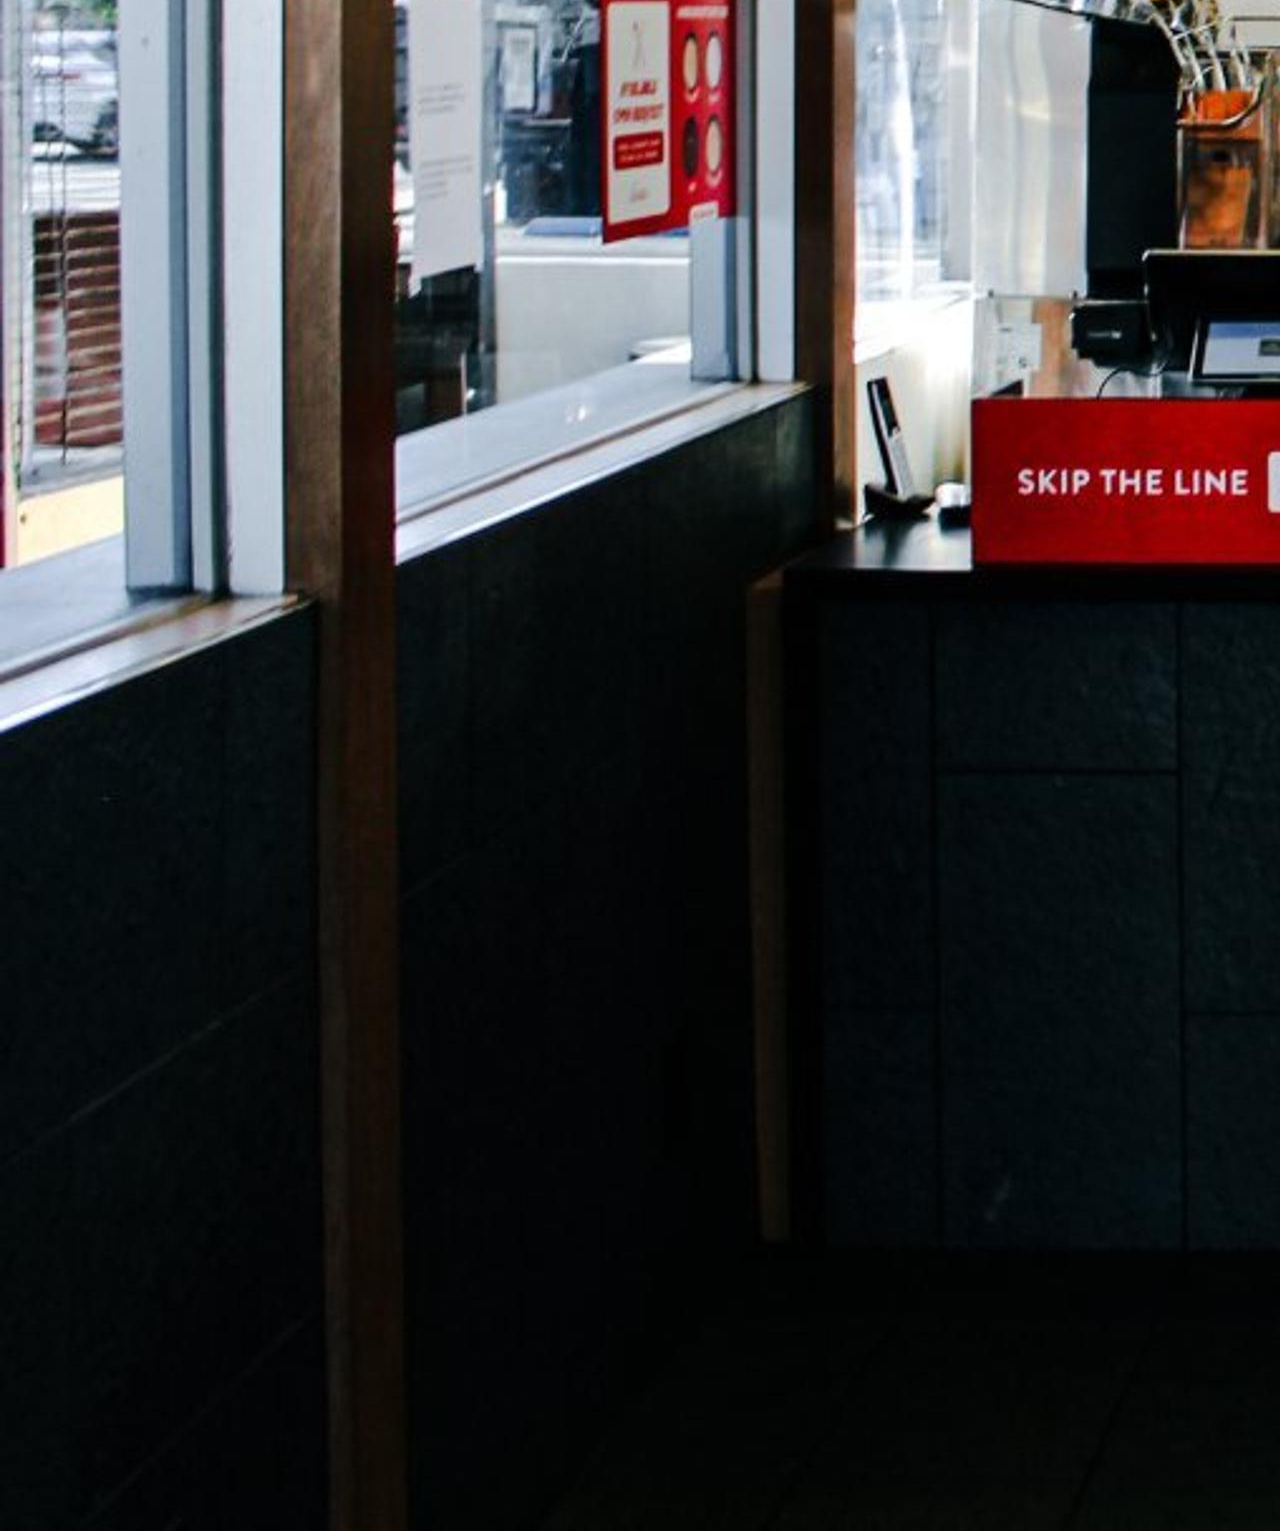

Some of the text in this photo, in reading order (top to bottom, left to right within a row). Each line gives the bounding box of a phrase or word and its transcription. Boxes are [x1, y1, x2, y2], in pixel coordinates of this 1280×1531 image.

[1017, 469, 1090, 496] SKIP
[1100, 469, 1163, 496] THE
[1174, 469, 1249, 496] LINE
